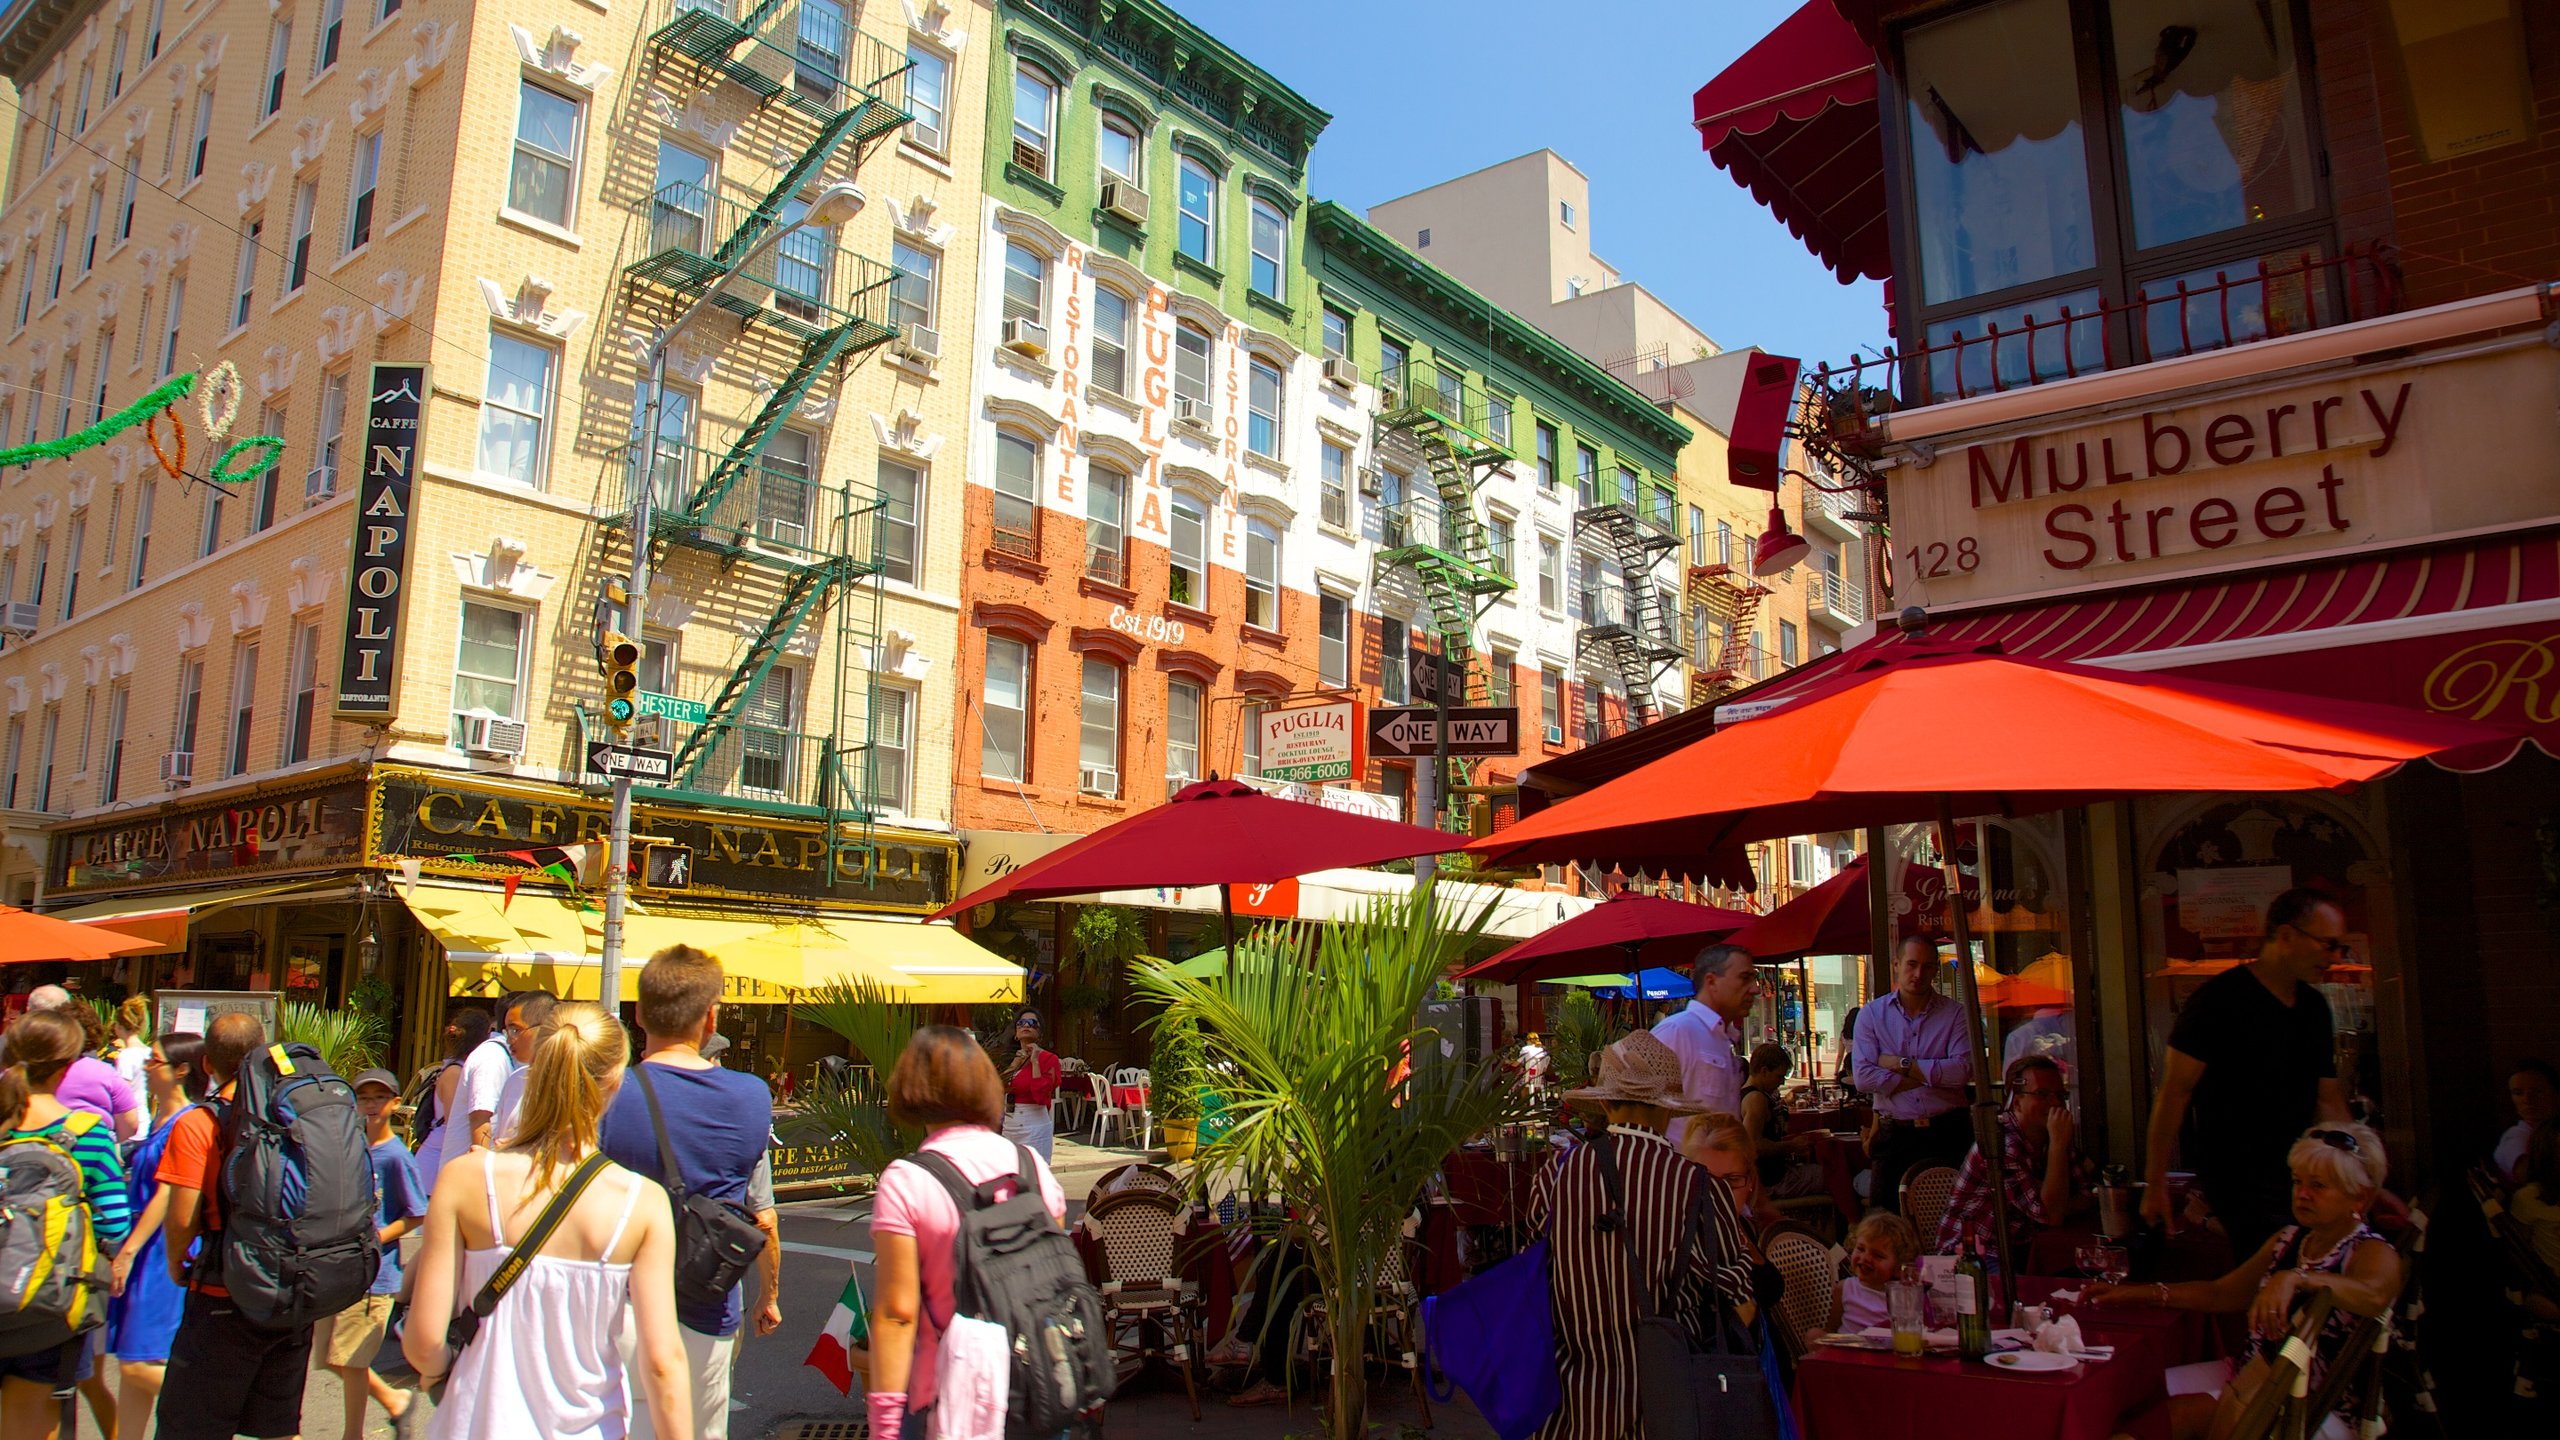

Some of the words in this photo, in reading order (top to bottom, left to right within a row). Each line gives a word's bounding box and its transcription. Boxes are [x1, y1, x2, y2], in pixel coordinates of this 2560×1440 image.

[1057, 243, 1083, 503] RISTORANTE
[370, 417, 418, 430] CAFFE
[1136, 284, 1171, 536] PUGLIA
[1222, 320, 1240, 558] RISTORANTE
[2042, 463, 2351, 571] Street
[354, 444, 412, 682] NAPOLI
[1905, 535, 1981, 579] 128
[1145, 614, 1185, 645] 1919
[1419, 666, 1435, 688] ONE
[1447, 675, 1459, 695] AY
[2422, 633, 2560, 724] R
[340, 693, 389, 703] RISTORANTE
[640, 693, 692, 720] HESTER
[693, 704, 704, 715] ST
[1269, 711, 1345, 740] PUGLIA
[1392, 723, 1433, 742] ONE
[1453, 722, 1499, 741] WAY
[1277, 748, 1308, 758] COCKTAIL
[1309, 746, 1335, 754] LOUNGE
[1286, 739, 1327, 750] RESTAURANT
[1317, 753, 1336, 762] PIZZA
[600, 753, 625, 768] ONE
[636, 757, 662, 772] WAY
[1265, 762, 1349, 781] 212-966-6006
[1290, 784, 1317, 797] The
[1321, 791, 1352, 802] Best
[82, 826, 166, 867] CAFFE
[186, 797, 324, 852] NAPOLI
[702, 825, 922, 882] NAPOLI
[983, 853, 1021, 876] Pu
[770, 1166, 799, 1177] AFOOD
[491, 1255, 525, 1294] Nikon
